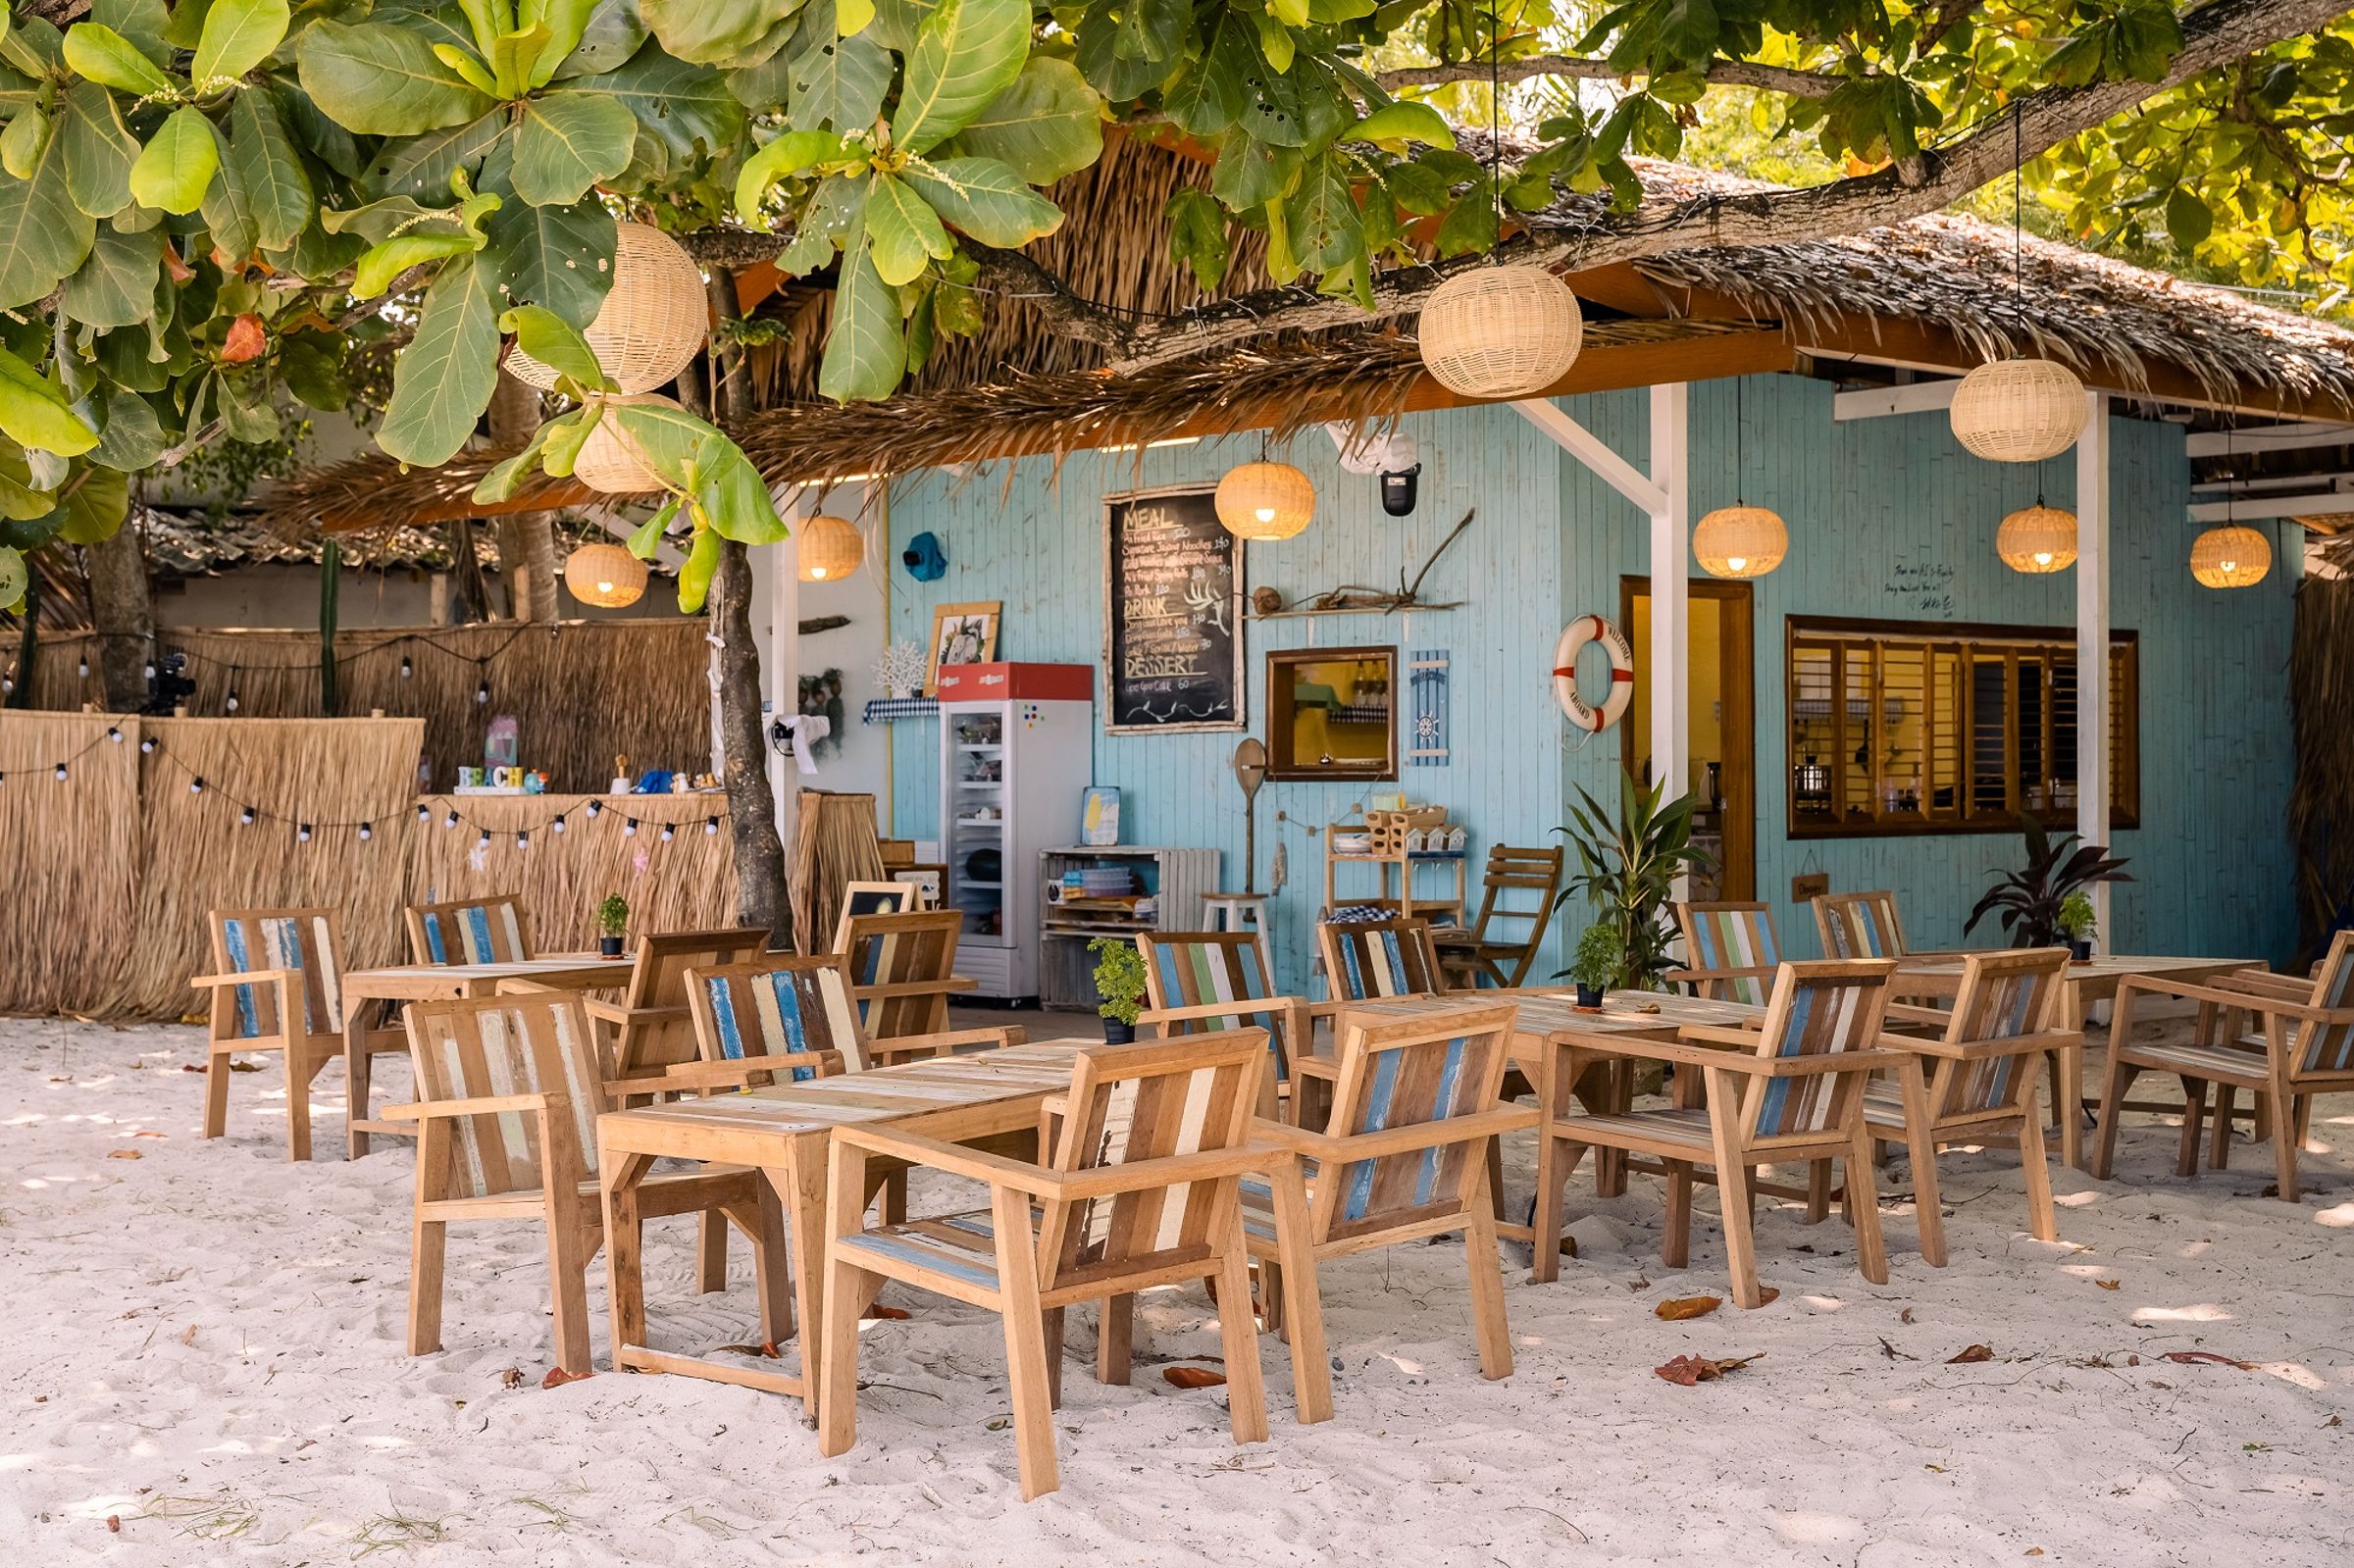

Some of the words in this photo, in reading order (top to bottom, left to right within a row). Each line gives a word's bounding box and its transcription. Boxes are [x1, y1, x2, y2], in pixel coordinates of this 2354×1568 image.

[1123, 507, 1174, 530] MEAL
[1182, 538, 1212, 551] Noodles
[1124, 596, 1168, 618] DRINK
[1608, 627, 1630, 663] WELCOME
[1124, 655, 1199, 679] DESSERT
[1569, 691, 1591, 720] ABOARD
[457, 766, 525, 787] BEACH
